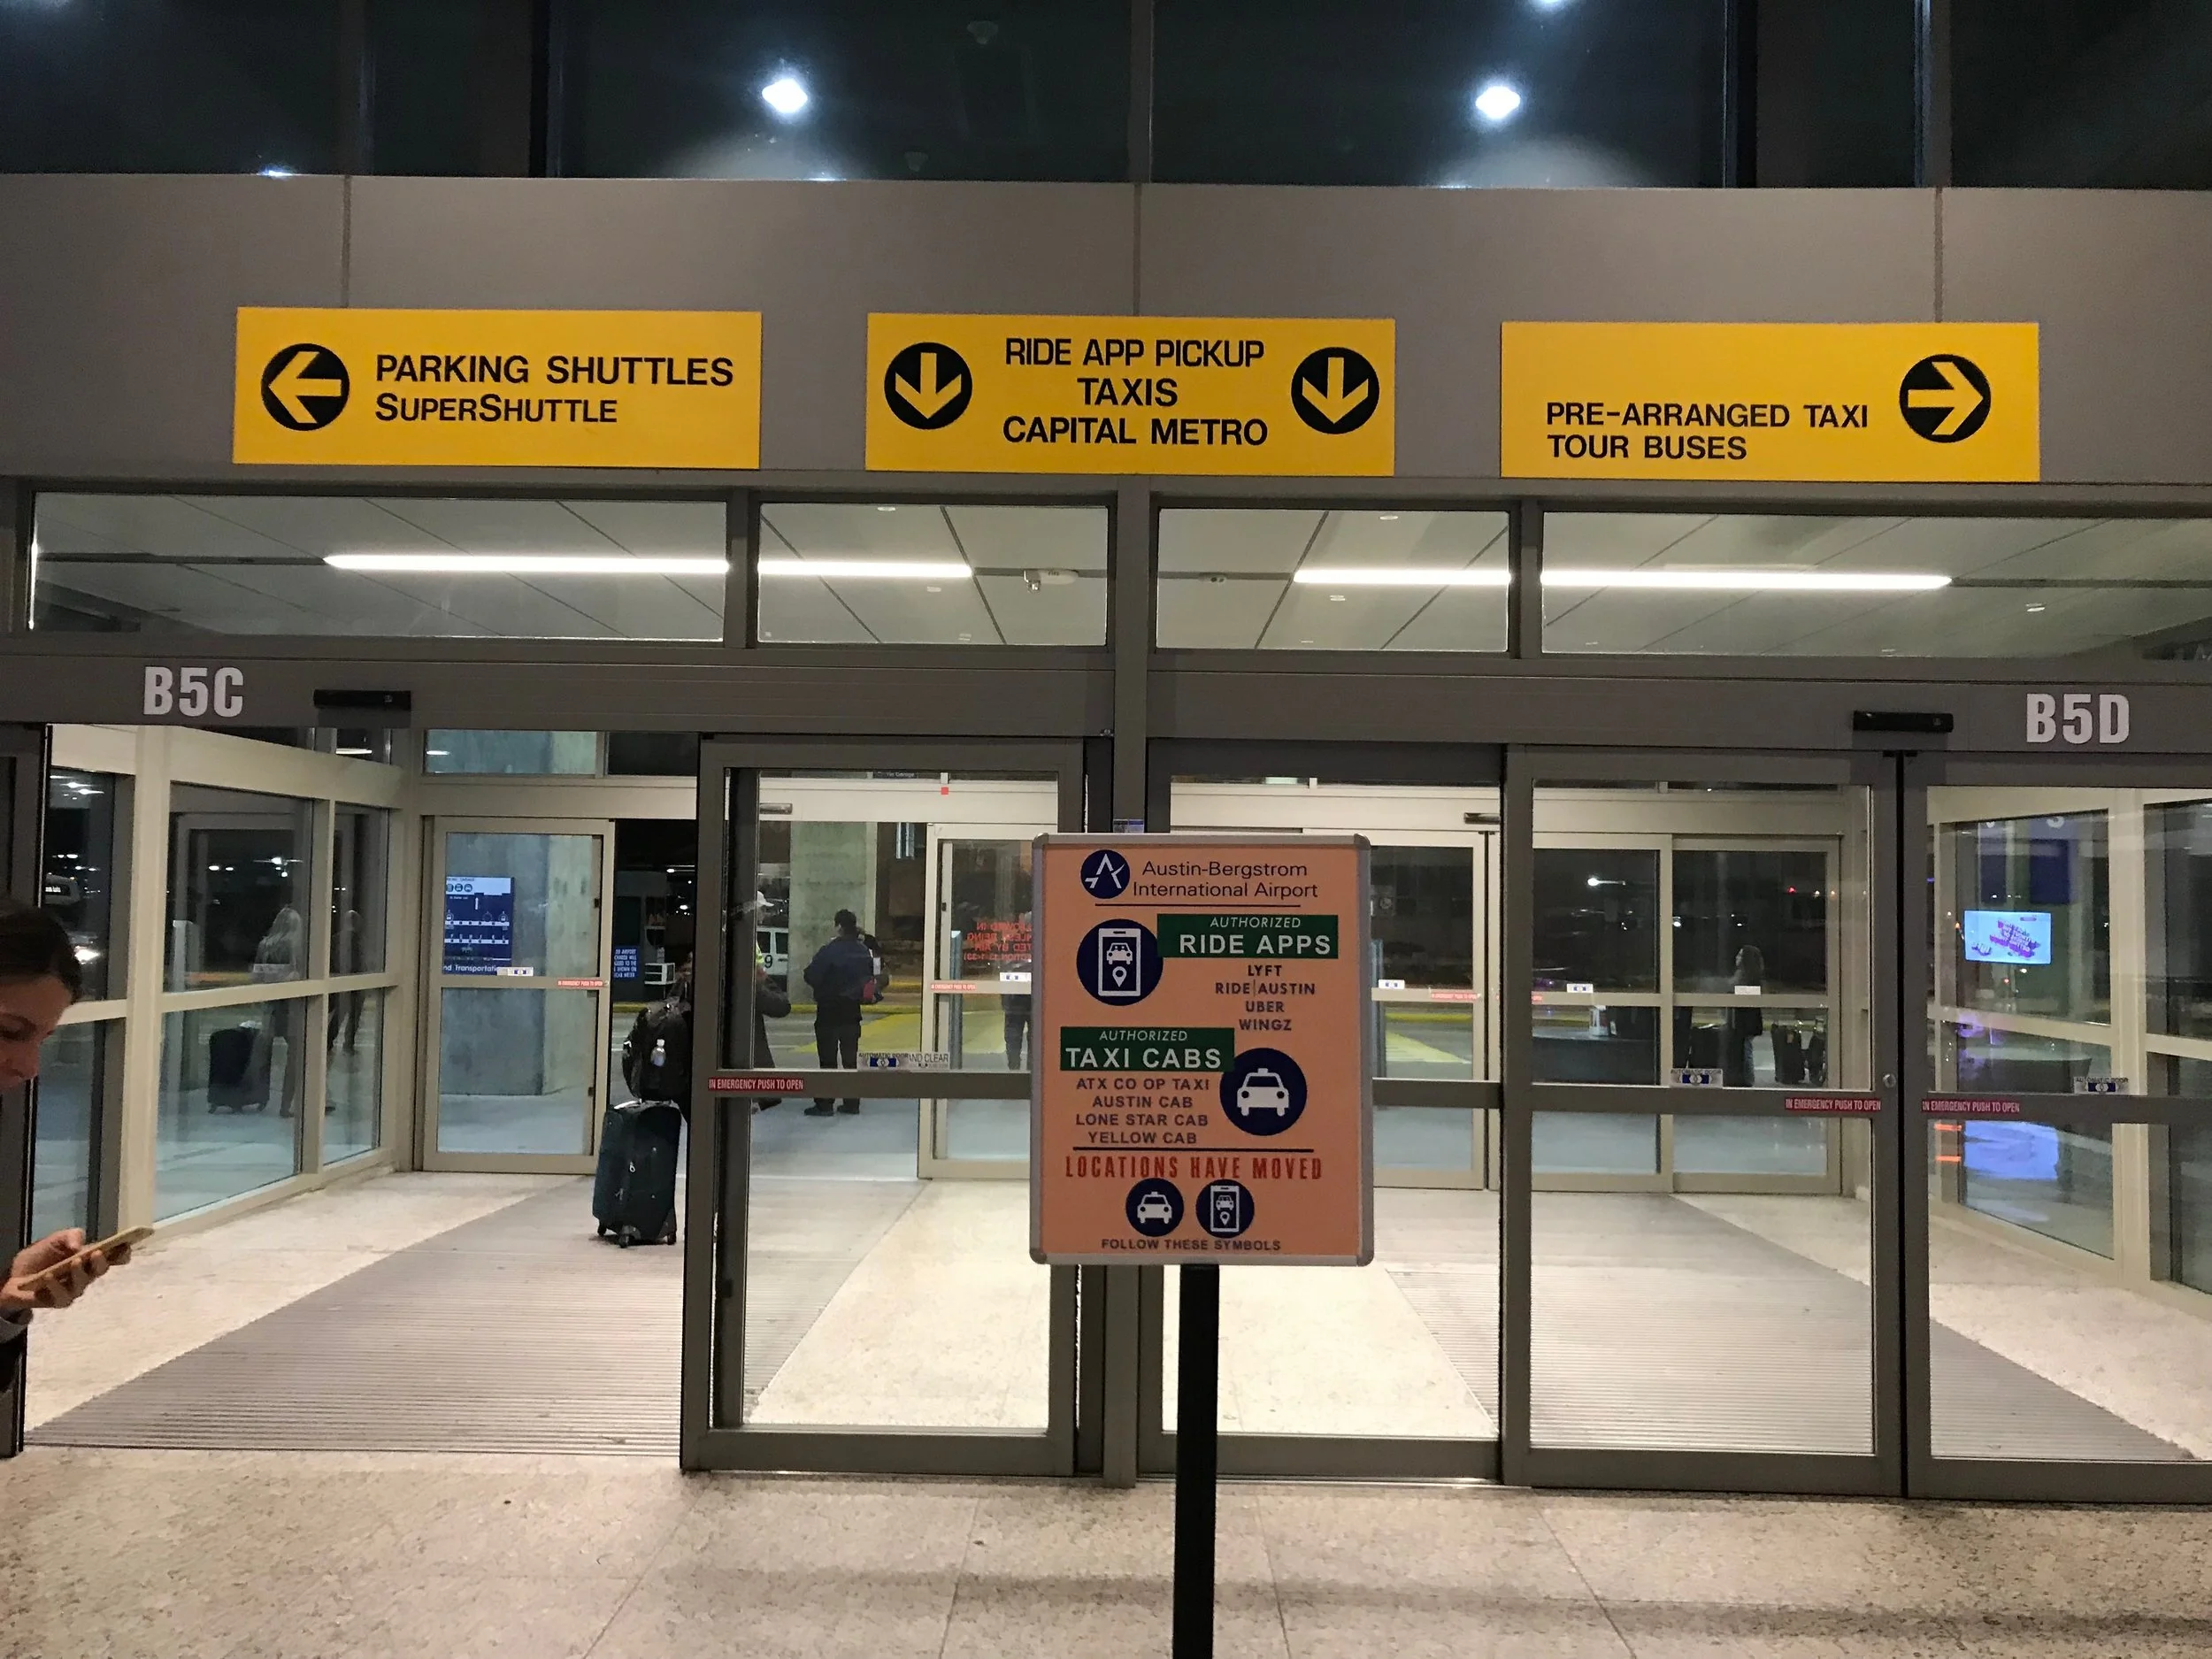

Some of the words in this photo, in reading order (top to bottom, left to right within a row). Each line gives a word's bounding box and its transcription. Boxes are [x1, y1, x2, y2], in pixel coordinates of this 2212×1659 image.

[1005, 338, 1071, 365] RIDE
[1082, 339, 1144, 366] APP
[1156, 340, 1264, 367] PICKUP
[376, 354, 529, 383] PARKING
[546, 355, 733, 387] SHUTTLES
[1077, 378, 1178, 407] TAXIS
[1547, 402, 1790, 427] PRE-ARRANGED
[1803, 404, 1868, 428] TAXI
[1002, 416, 1137, 444] CAPITAL
[1150, 418, 1268, 446] METRO
[1547, 434, 1629, 458] TOUR
[1644, 435, 1747, 460] BUSES
[143, 666, 244, 718] B5C
[2026, 693, 2130, 744] B5D
[1141, 861, 1308, 879] Austin-Bergstrom
[1133, 881, 1248, 897] International
[1254, 882, 1318, 901] Airport
[1210, 917, 1302, 928] AUTHORIZED
[1179, 934, 1244, 955] RIDE
[1256, 934, 1331, 956] APPS
[1248, 964, 1282, 977] LYFT
[1245, 1001, 1285, 1012] UBER
[1239, 1018, 1292, 1031] WINGZ
[1099, 1030, 1188, 1041] AUTHORIZED
[925, 1053, 949, 1063] CLEAR
[1065, 1048, 1130, 1068] TAXI
[1142, 1048, 1222, 1069] CABS
[709, 1079, 716, 1089] IN
[717, 1079, 757, 1089] EMERGENCY
[757, 1079, 775, 1090] PUSH
[777, 1079, 785, 1090] TO
[786, 1079, 803, 1090] OPEN
[1076, 1078, 1107, 1090] ATX
[1114, 1078, 1137, 1090] CO
[1143, 1078, 1165, 1090] OP
[1172, 1079, 1210, 1090] TAXI
[1092, 1096, 1152, 1108] AUSTIN
[1159, 1096, 1193, 1108] CAB
[1786, 1099, 1793, 1109] IN
[1794, 1099, 1833, 1110] EMERGENCY
[1834, 1100, 1853, 1110] PUSH
[1854, 1100, 1863, 1110] TO
[1863, 1100, 1881, 1110] OPEN
[1931, 1101, 1970, 1111] EMERGENCY
[1972, 1102, 1990, 1112] PUSH
[1992, 1102, 2001, 1112] TO
[2001, 1102, 2020, 1112] OPEN
[1076, 1114, 1118, 1125] LONE
[1125, 1114, 1167, 1126] STAR
[1174, 1114, 1208, 1126] CAB
[1088, 1132, 1156, 1144] YELLOW
[1163, 1132, 1197, 1144] CAB
[1065, 1156, 1179, 1178] LOCATIONS
[1190, 1156, 1240, 1179] HAVE
[1252, 1157, 1322, 1179] MOVED
[1101, 1239, 1159, 1249] FOLLOW
[1165, 1239, 1211, 1250] THESE
[1214, 1240, 1281, 1250] SYMBOLS
